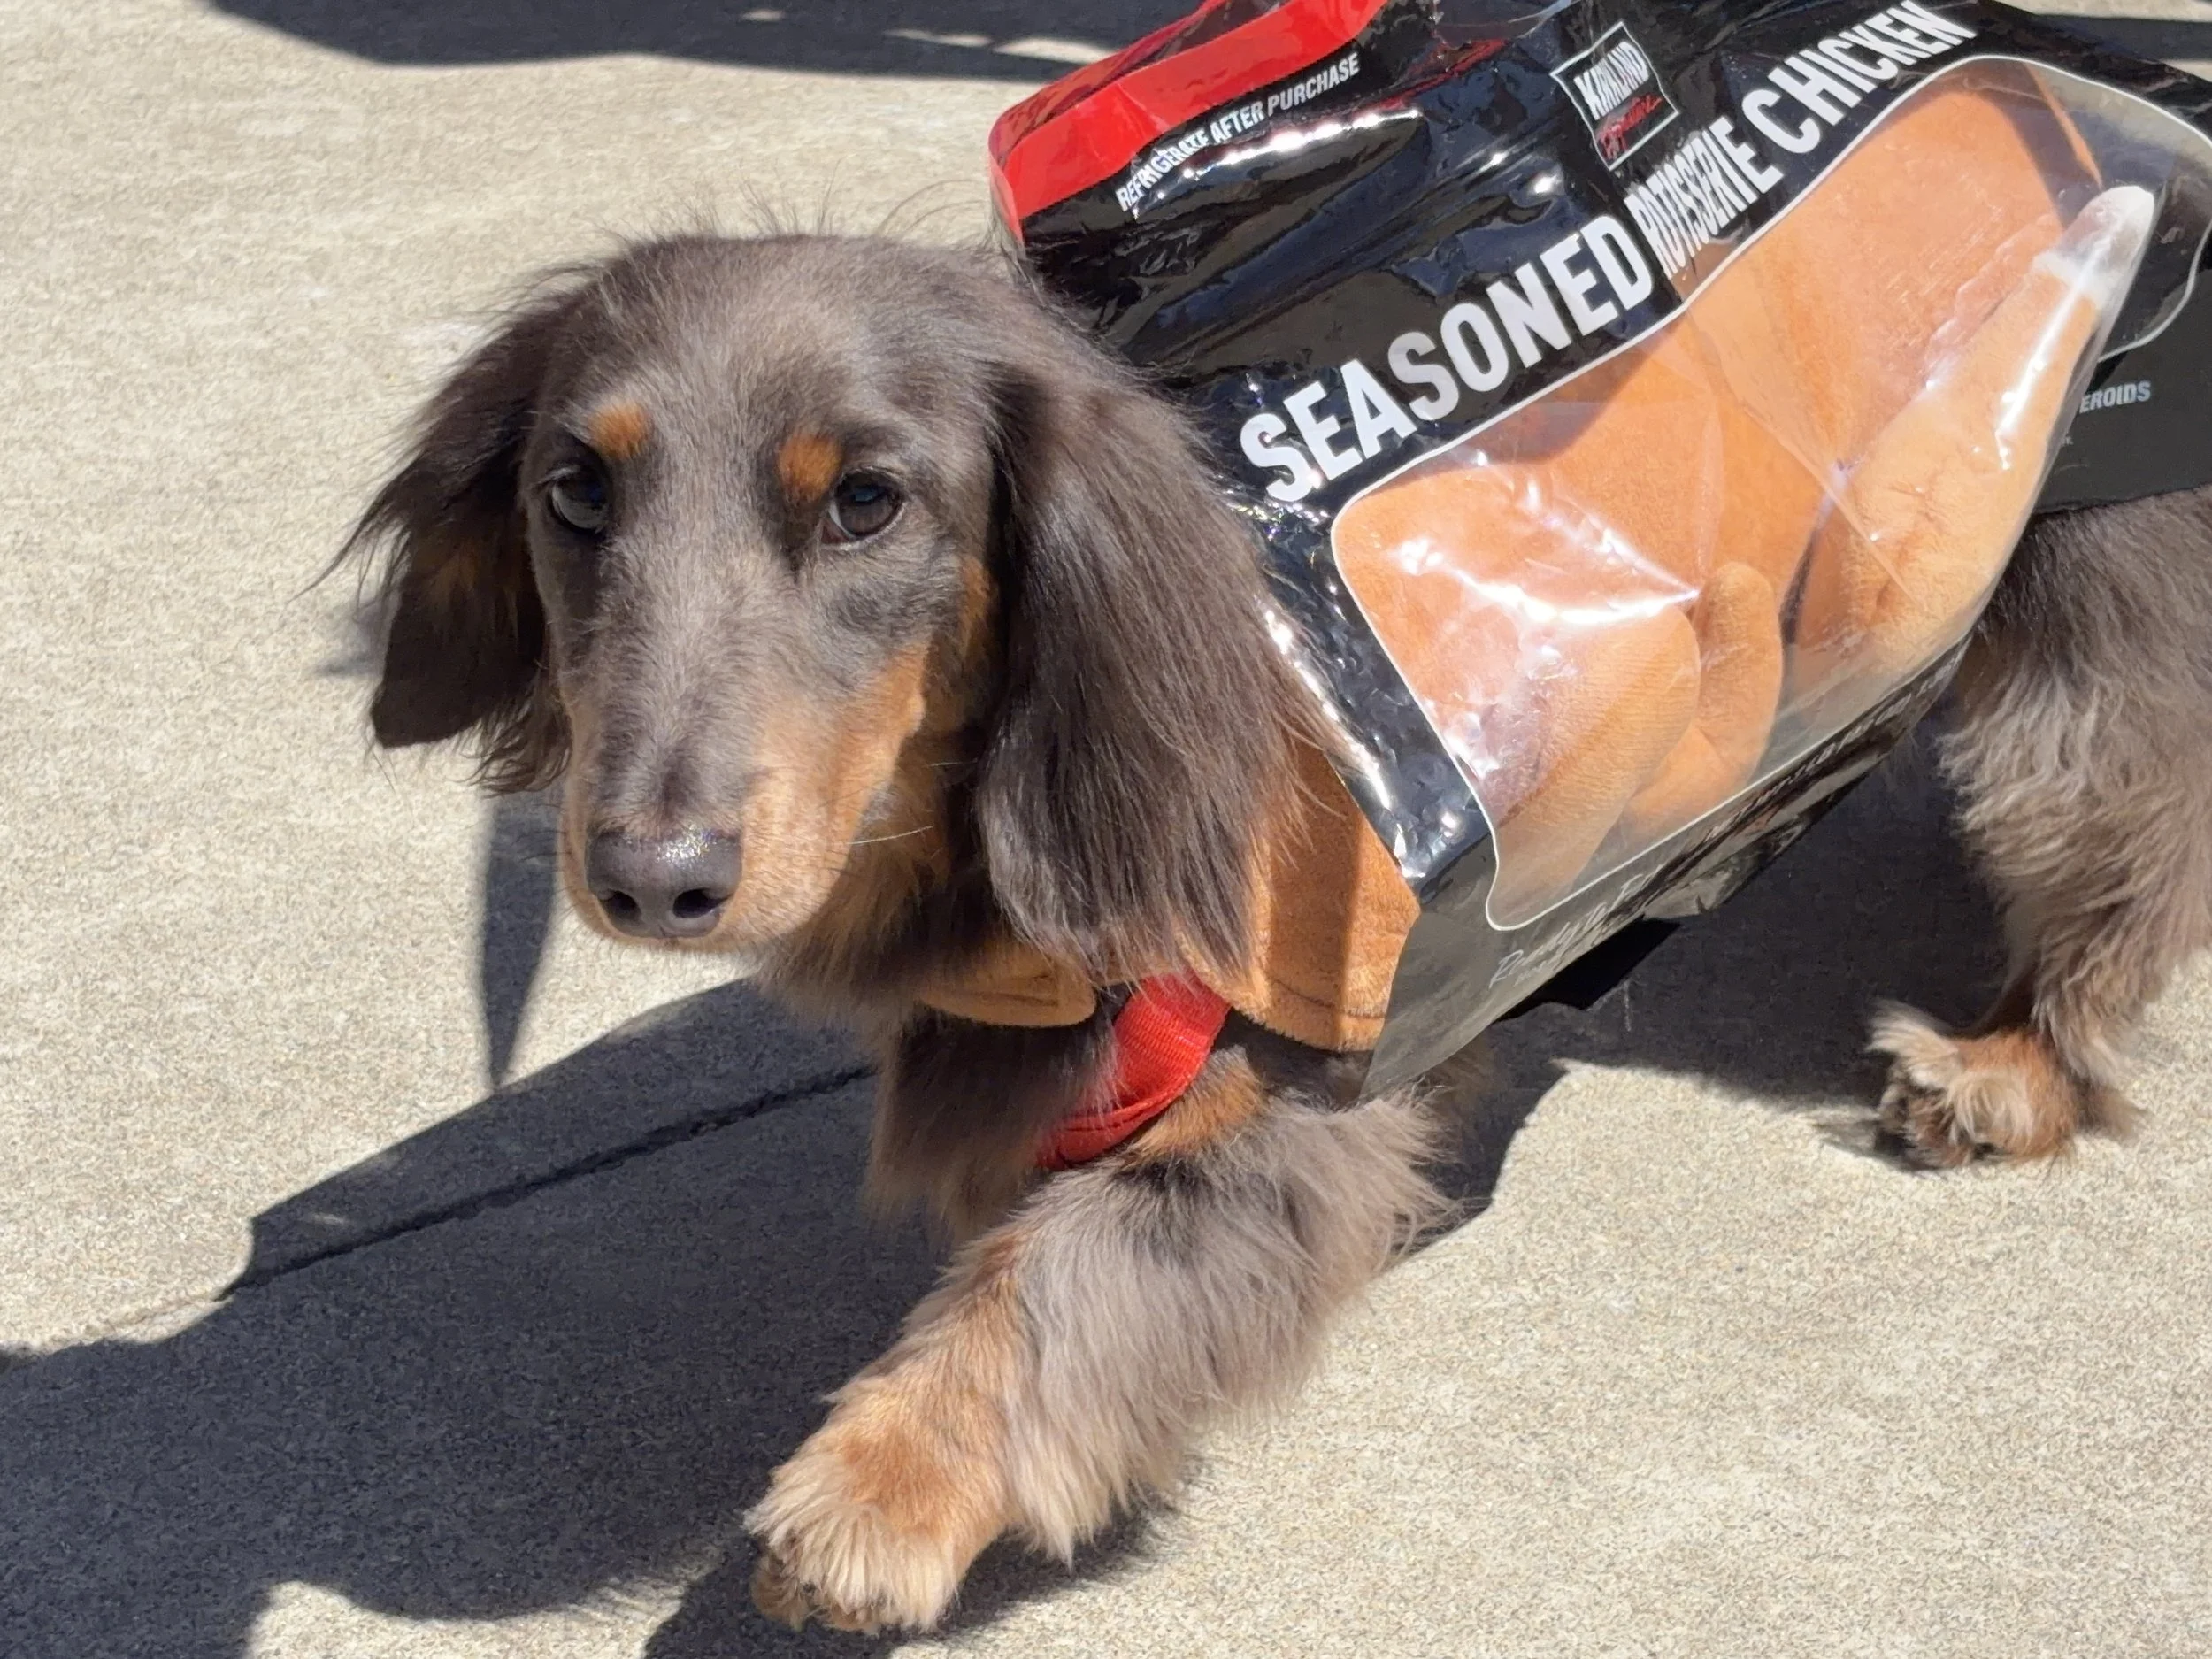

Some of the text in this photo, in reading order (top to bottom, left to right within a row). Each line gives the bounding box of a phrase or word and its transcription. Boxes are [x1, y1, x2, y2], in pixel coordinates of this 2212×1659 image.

[1115, 51, 1361, 212] REFRIGERATE AFTER PURCHASE
[1573, 41, 1649, 120] KIRKLAND
[1240, 215, 1652, 502] SEASONED
[1624, 116, 1784, 280] ROTISSERIE
[1741, 0, 1977, 153] CHICKEN
[2079, 380, 2151, 414] EROIDS
